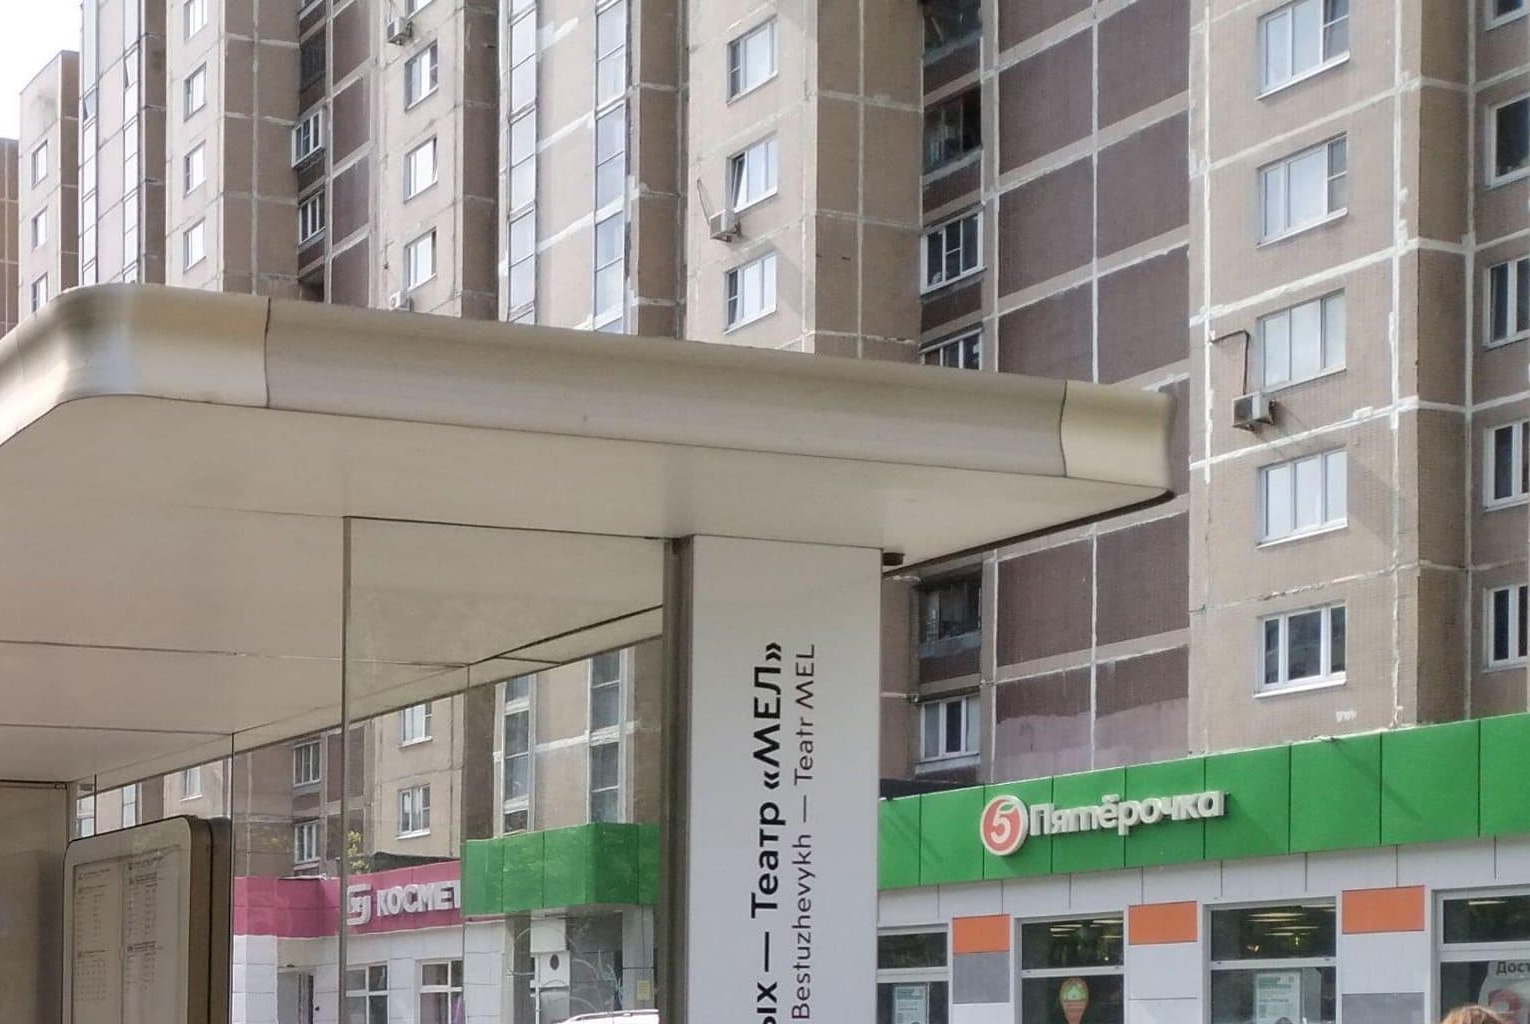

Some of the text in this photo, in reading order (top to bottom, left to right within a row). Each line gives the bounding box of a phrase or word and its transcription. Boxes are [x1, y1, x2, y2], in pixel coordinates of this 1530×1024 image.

[753, 642, 782, 790] «МЕЛ»
[795, 644, 815, 710] MEL
[794, 717, 814, 786] Teatr
[751, 800, 786, 919] Театр
[1029, 790, 1225, 836] Пятёрочка
[791, 834, 816, 1019] Bestuzhevykh
